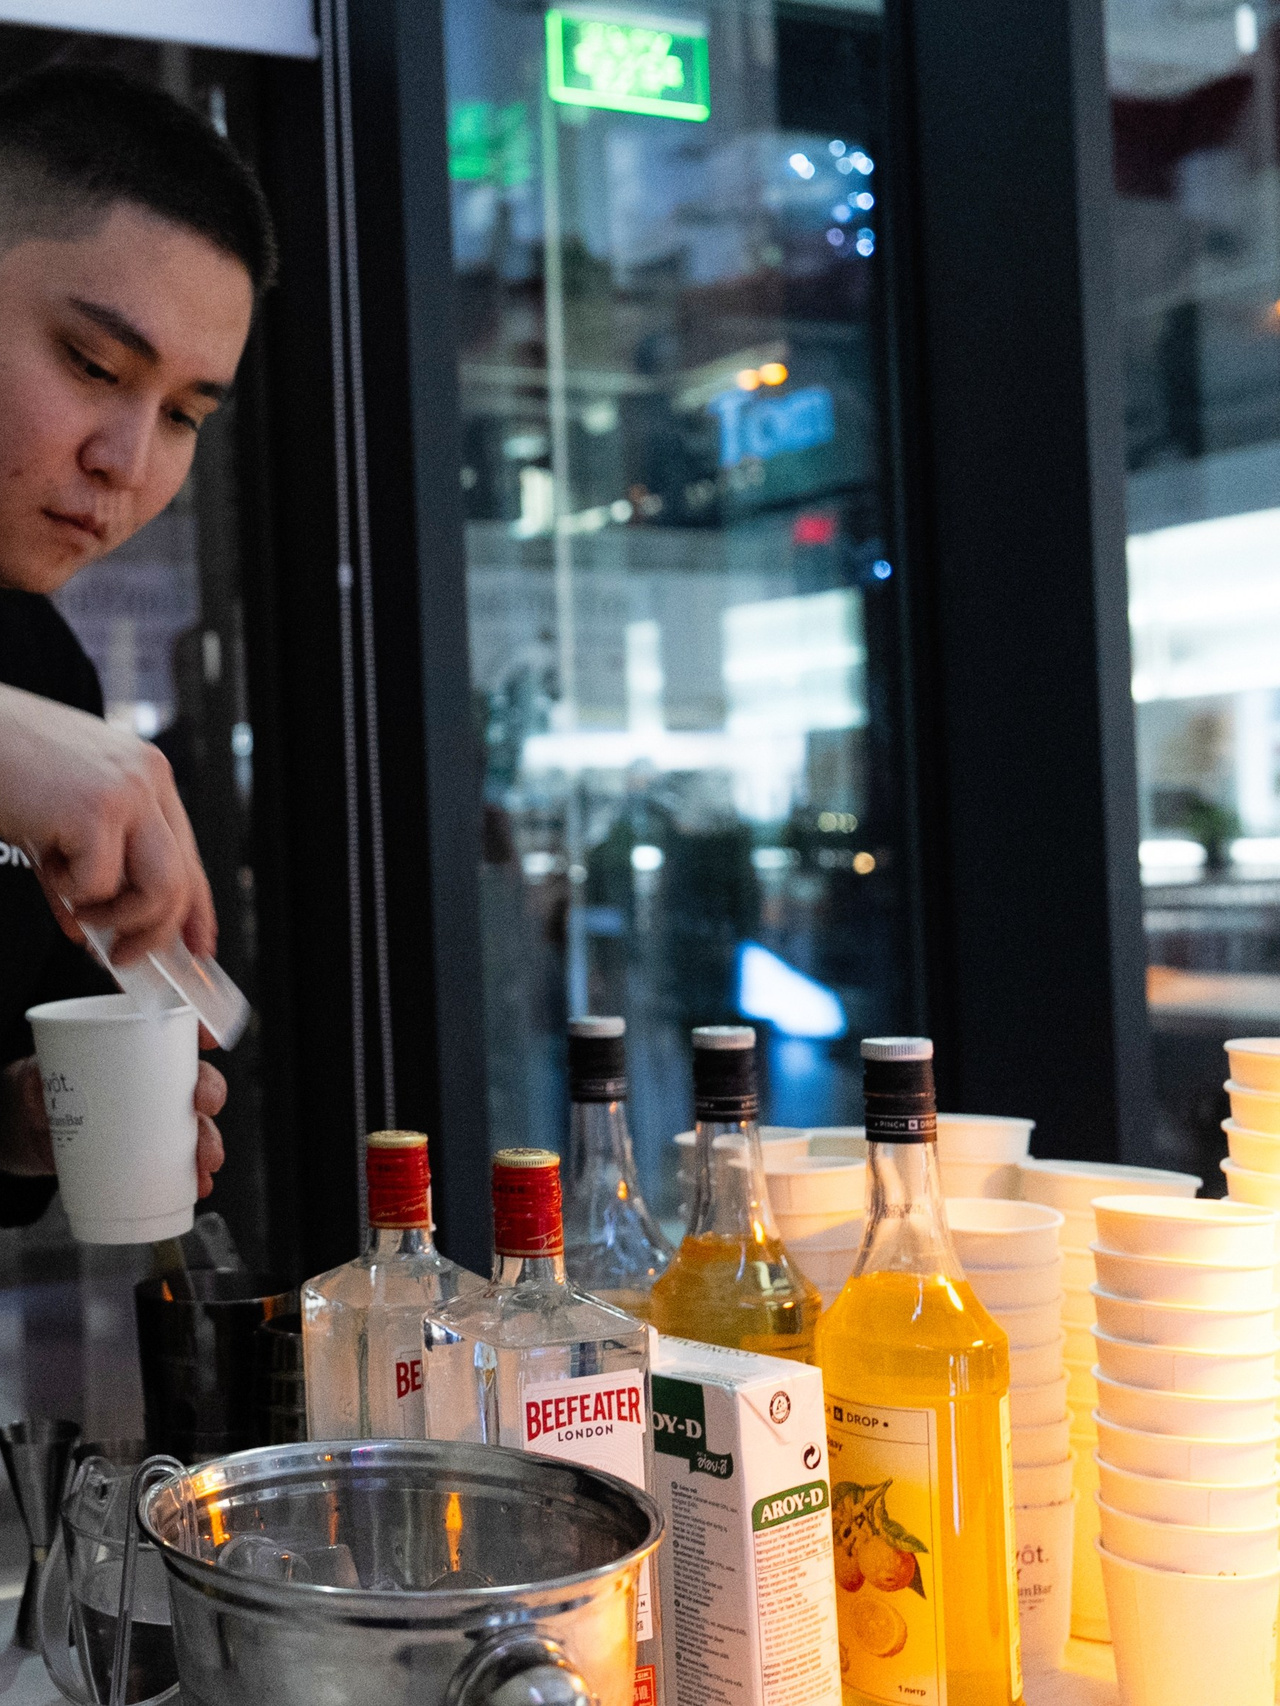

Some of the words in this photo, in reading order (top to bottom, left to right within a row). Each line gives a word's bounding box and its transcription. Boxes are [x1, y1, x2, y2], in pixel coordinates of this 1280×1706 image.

[525, 1386, 642, 1443] BEEFEATER
[846, 1411, 879, 1428] DROP
[557, 1424, 614, 1443] LONDON
[760, 1487, 824, 1524] AROY-D
[898, 1685, 903, 1693] 1
